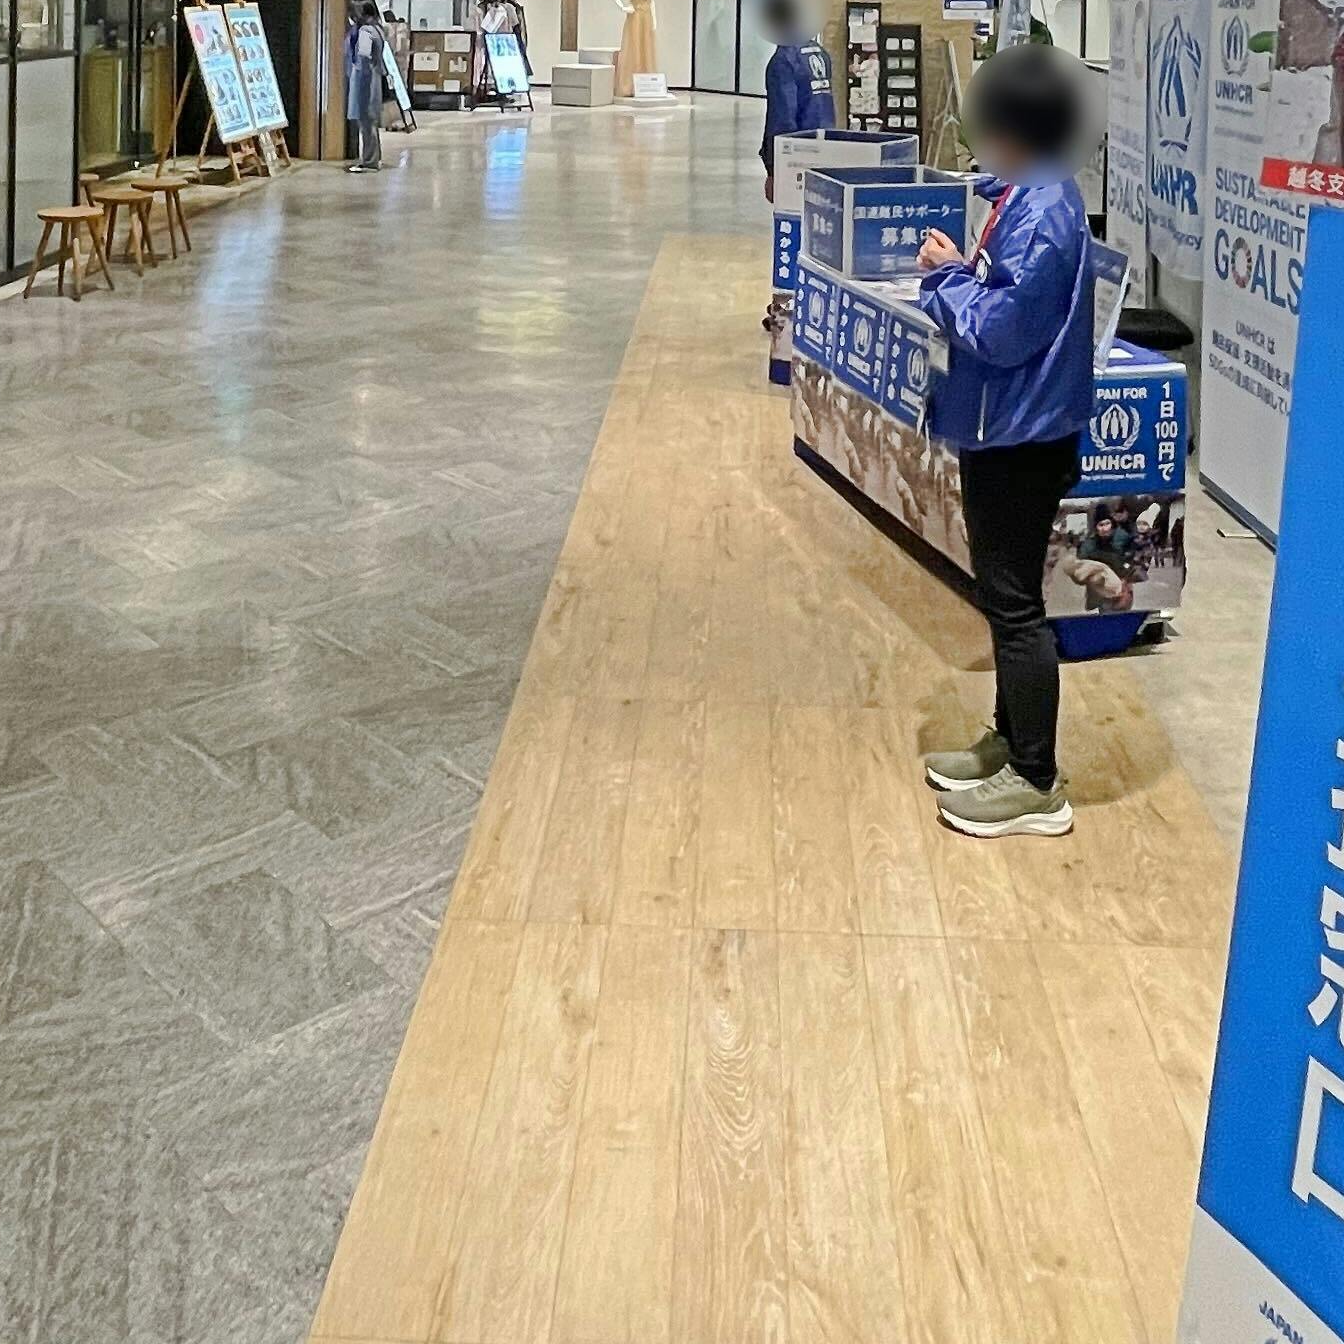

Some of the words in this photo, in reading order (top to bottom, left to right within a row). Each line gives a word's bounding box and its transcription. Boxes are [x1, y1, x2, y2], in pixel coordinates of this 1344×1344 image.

[1215, 80, 1253, 105] UNHCR
[1215, 196, 1306, 253] DEVELOPMENT
[1214, 228, 1304, 316] GOALS
[1123, 386, 1148, 400] FOR
[1154, 381, 1178, 481] 1日100円で
[1081, 453, 1146, 472] UNHCR
